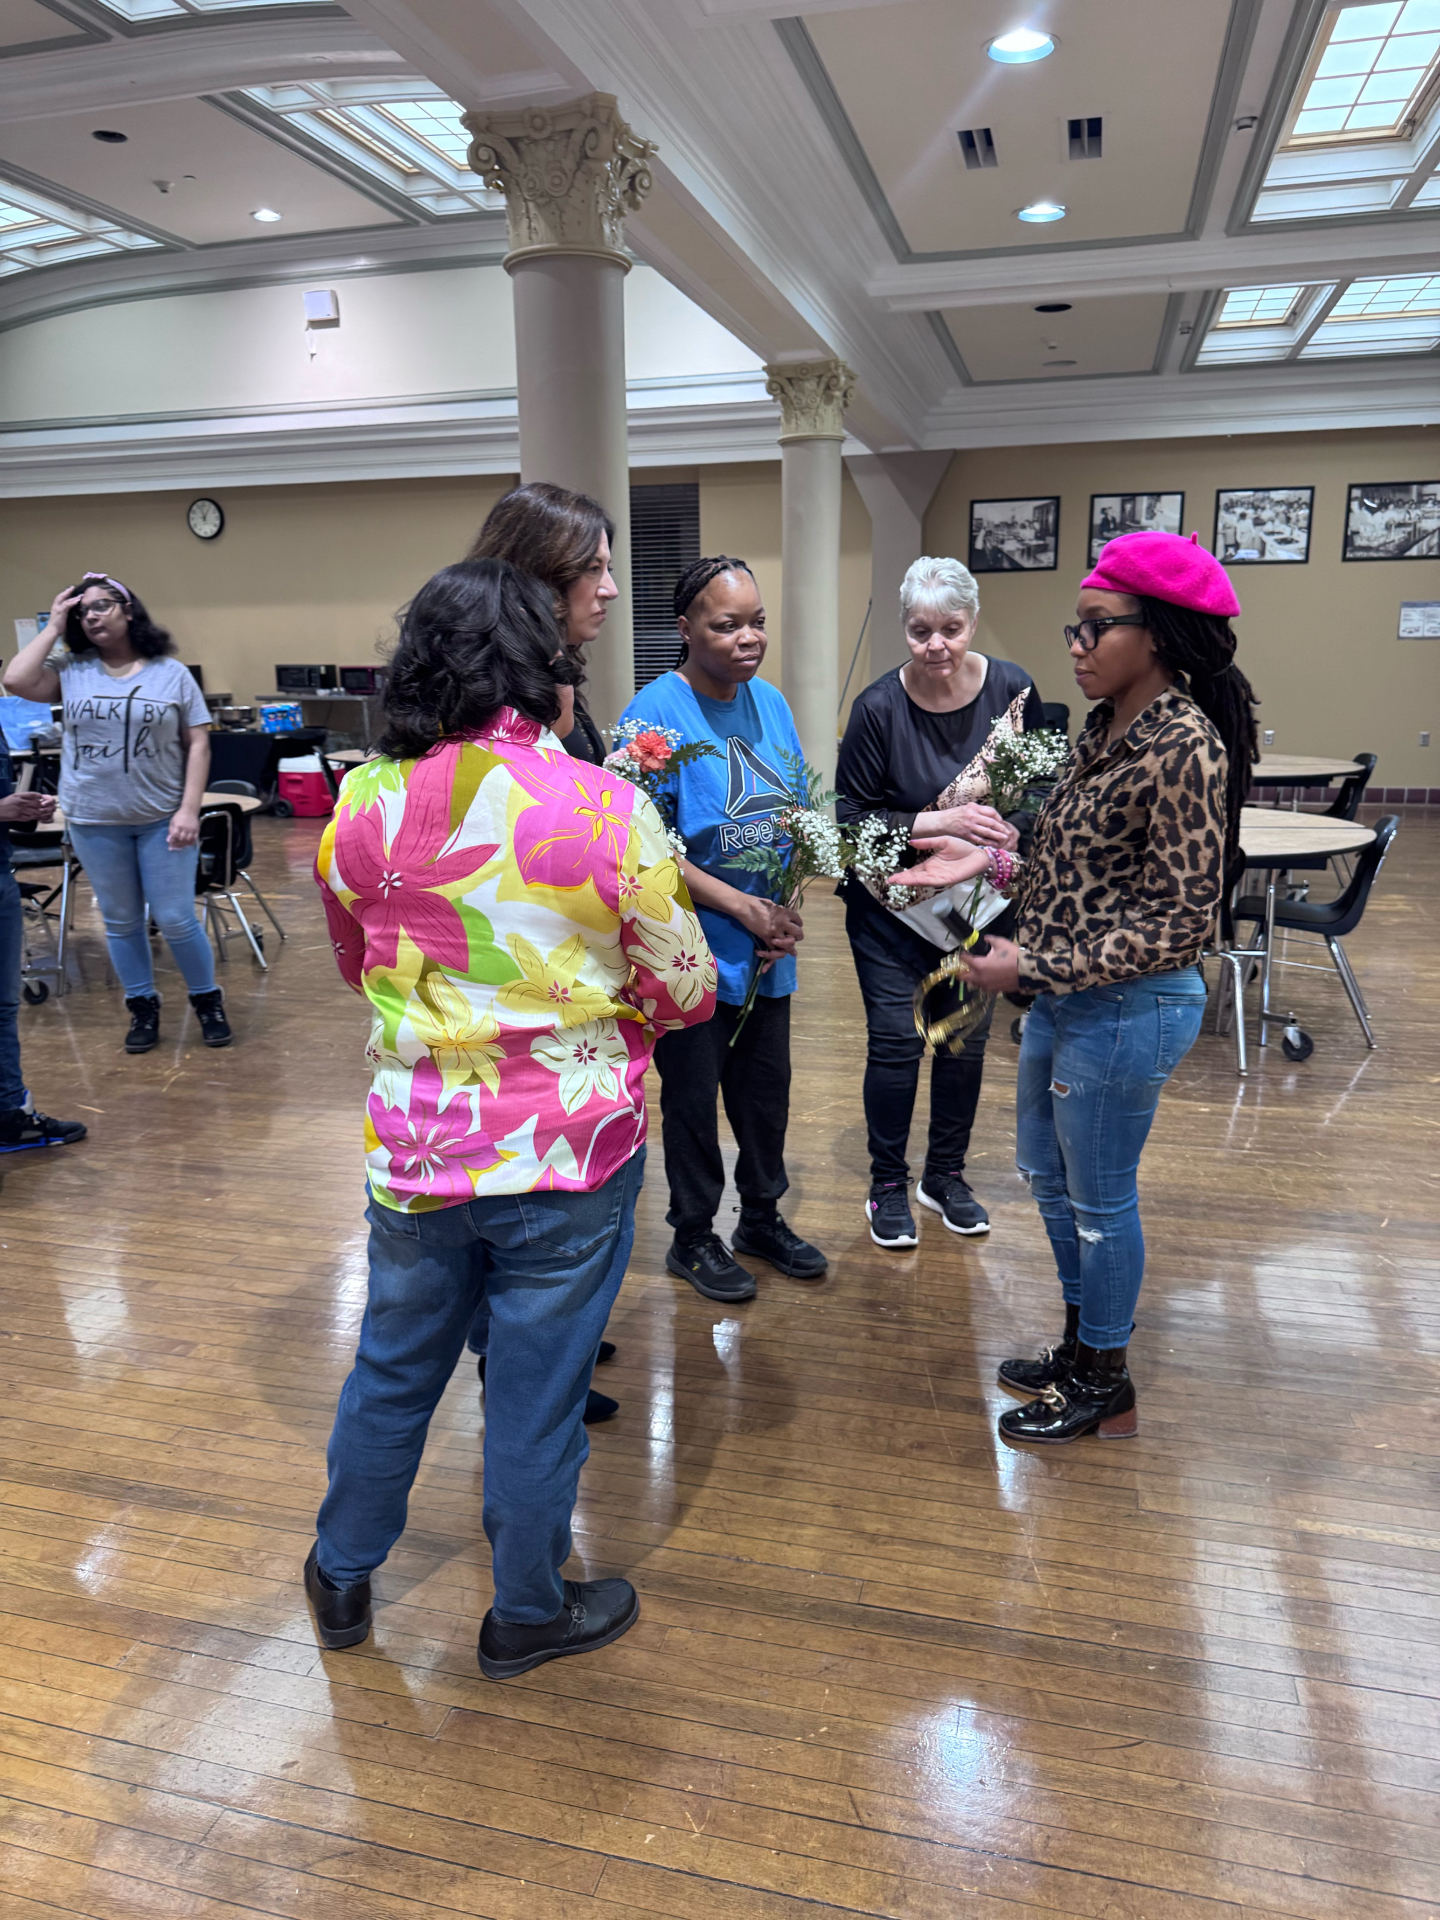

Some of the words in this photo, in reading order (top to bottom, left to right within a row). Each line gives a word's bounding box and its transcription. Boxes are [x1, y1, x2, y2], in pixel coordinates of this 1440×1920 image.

[66, 699, 121, 721] WALK
[143, 703, 168, 725] BY
[718, 813, 795, 853] Reeb
